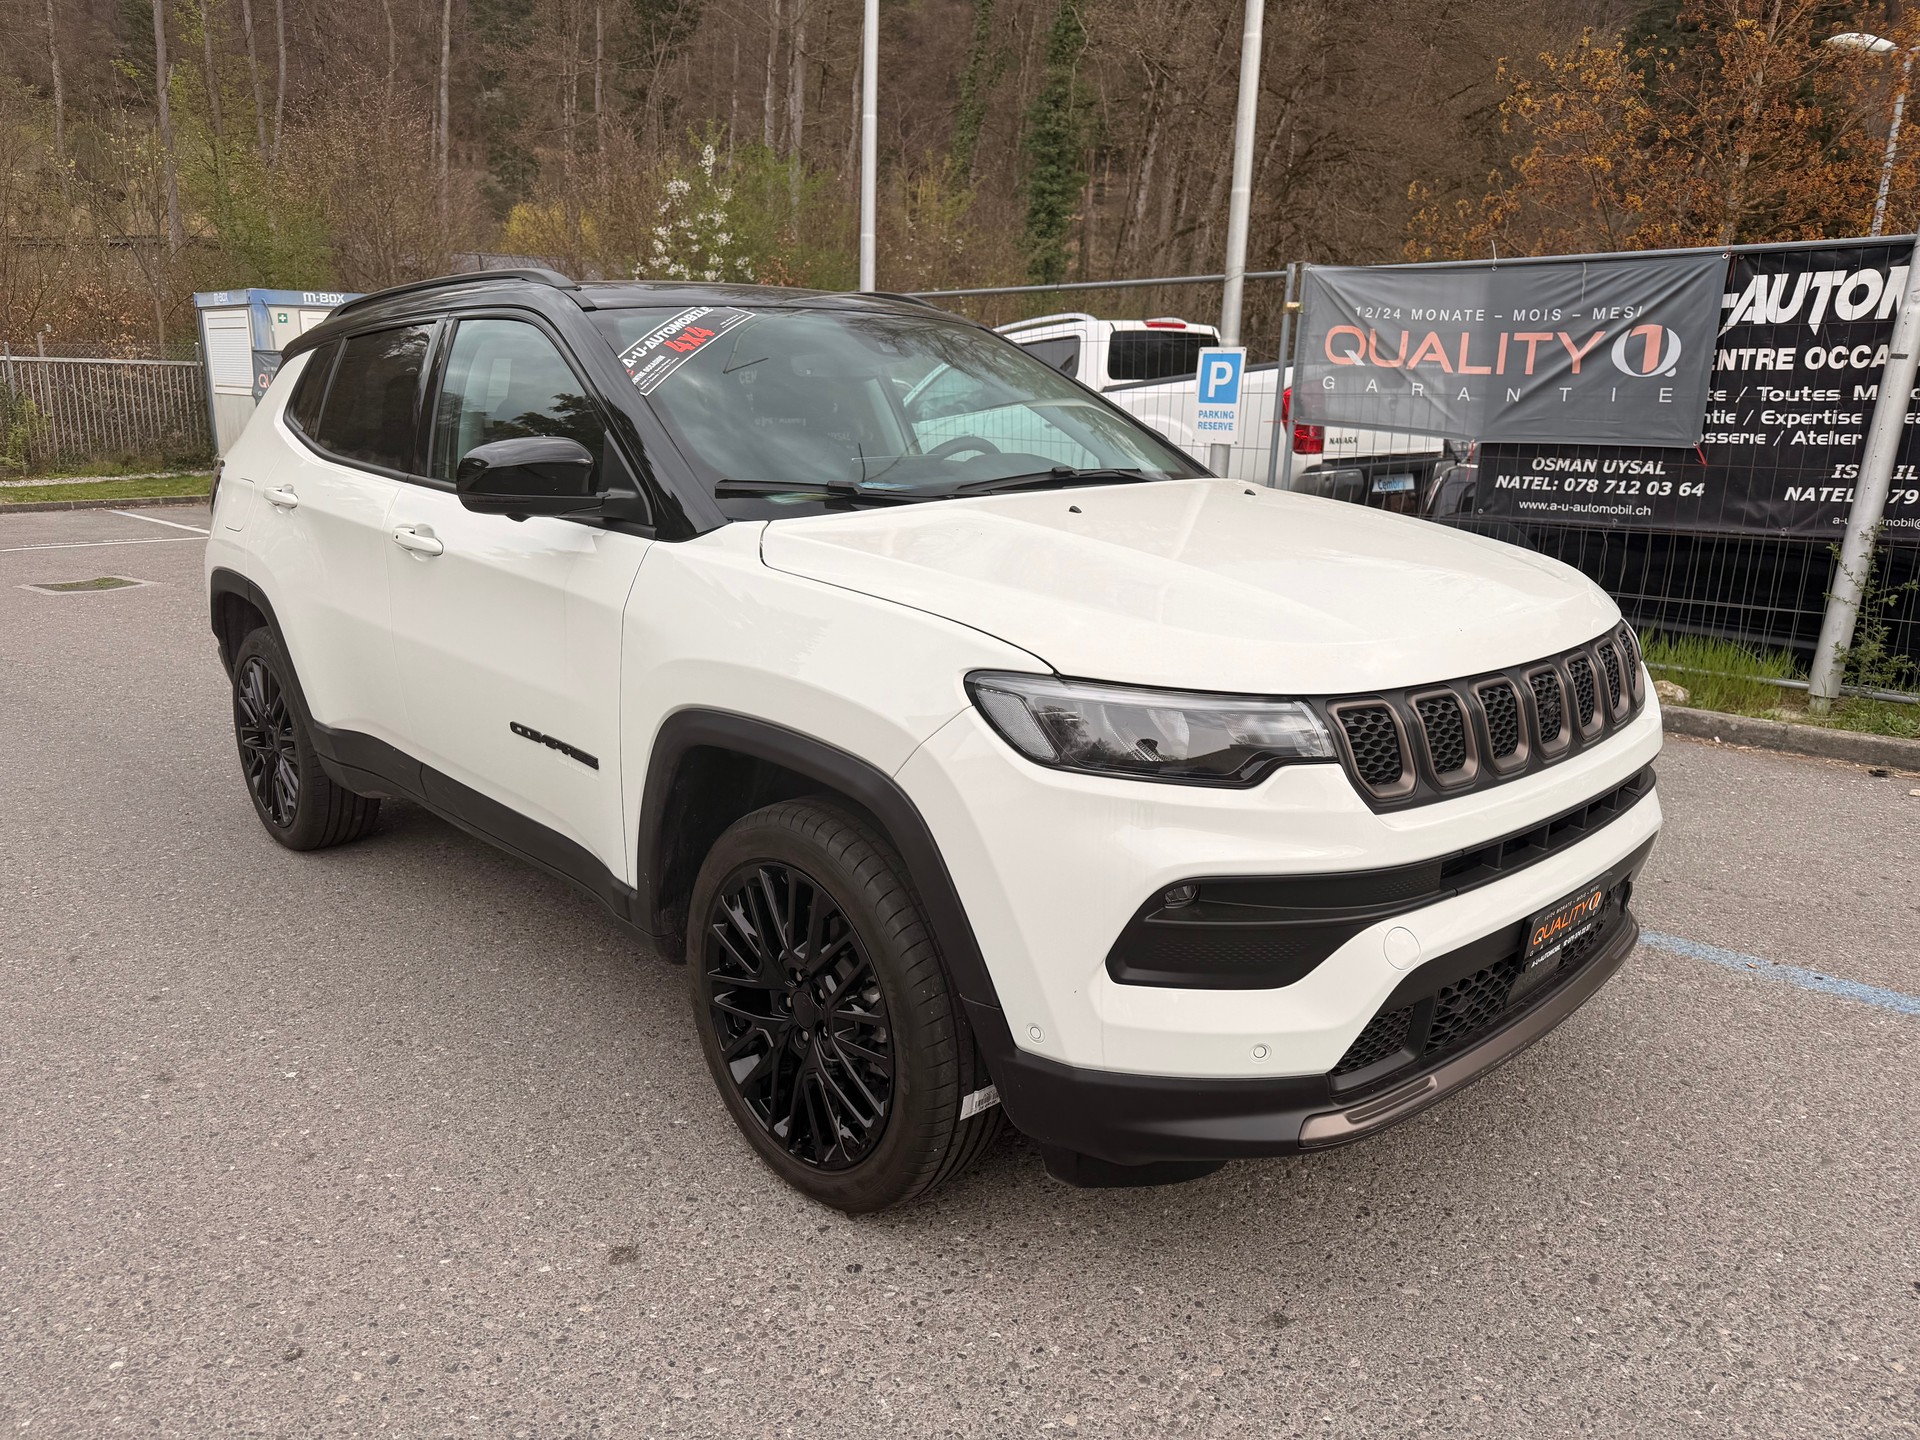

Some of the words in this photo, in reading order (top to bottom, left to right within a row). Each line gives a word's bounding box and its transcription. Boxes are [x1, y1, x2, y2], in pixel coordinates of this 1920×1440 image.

[1355, 305, 1402, 321] 12/24
[1411, 308, 1486, 322] MONATE
[1513, 308, 1562, 322] MOIS
[1324, 324, 1606, 375] QUALITY
[1207, 361, 1234, 398] P
[1756, 386, 1841, 402] Toutes
[1198, 410, 1235, 419] PARKING
[1760, 410, 1863, 428] Expertise
[1197, 421, 1234, 431] RESERVE
[1790, 430, 1862, 446] Atelier
[1531, 457, 1598, 473] OSMAN
[1602, 459, 1667, 475] UYSAL
[1495, 475, 1559, 491] NATEL:
[1563, 477, 1599, 493] 078
[1603, 479, 1641, 495] 712
[1646, 480, 1673, 496] 03
[1678, 482, 1706, 497] 64
[1518, 500, 1652, 516] www.a-u-automobil.ch
